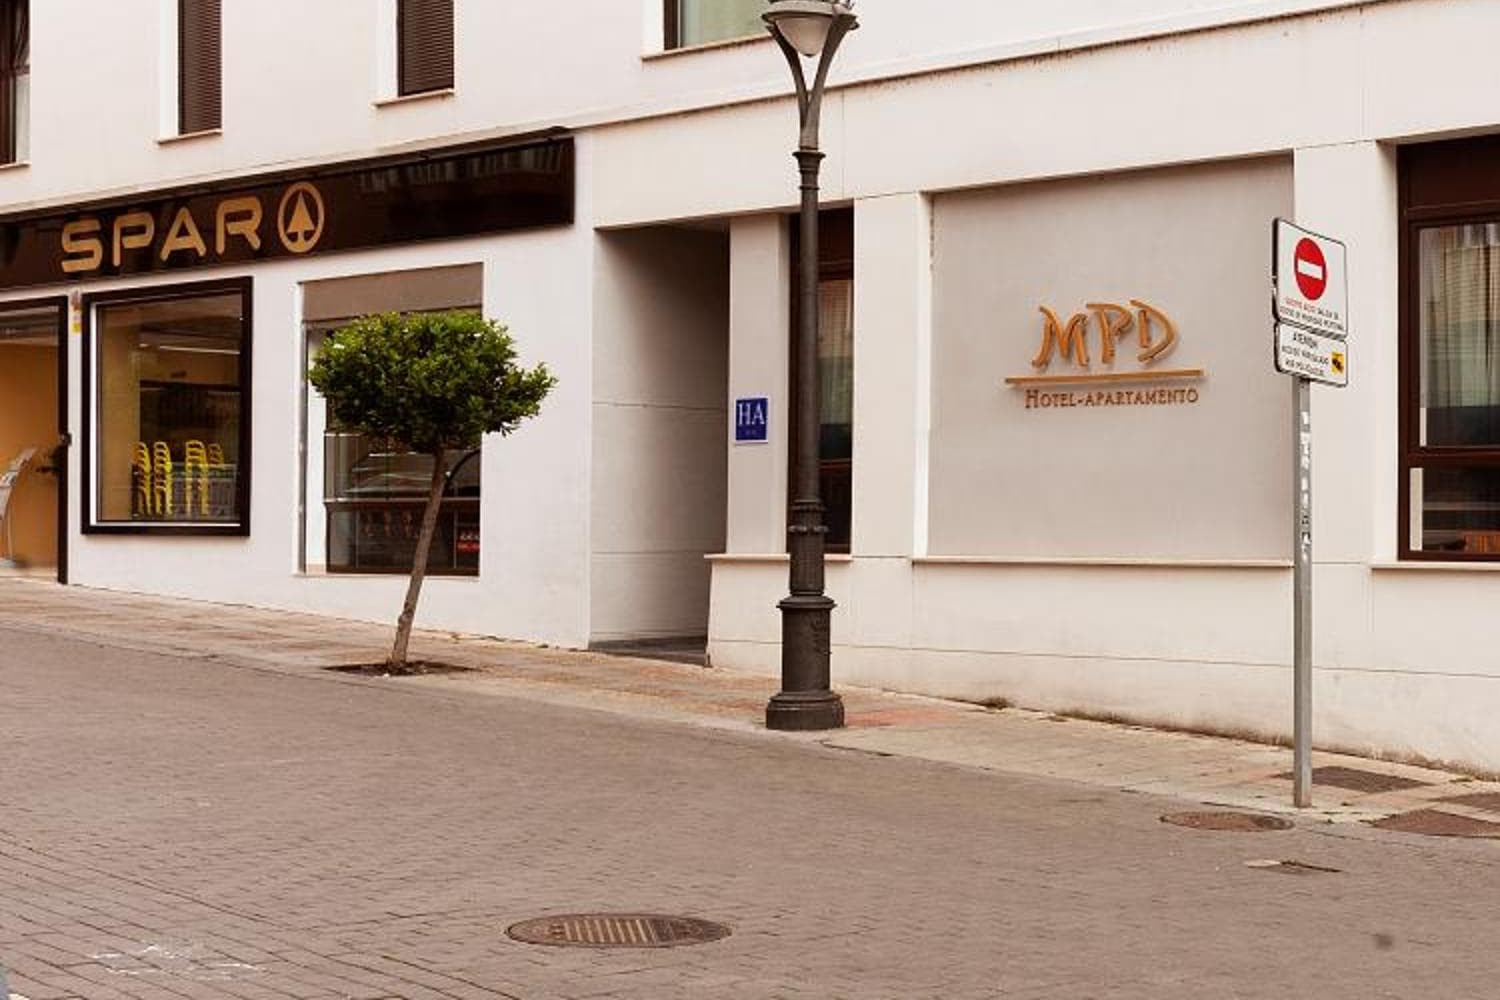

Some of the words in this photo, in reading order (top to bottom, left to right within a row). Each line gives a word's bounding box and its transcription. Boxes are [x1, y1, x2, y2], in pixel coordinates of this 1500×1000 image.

[61, 195, 263, 273] SPAR
[1031, 299, 1176, 367] MPD
[739, 402, 765, 425] HA
